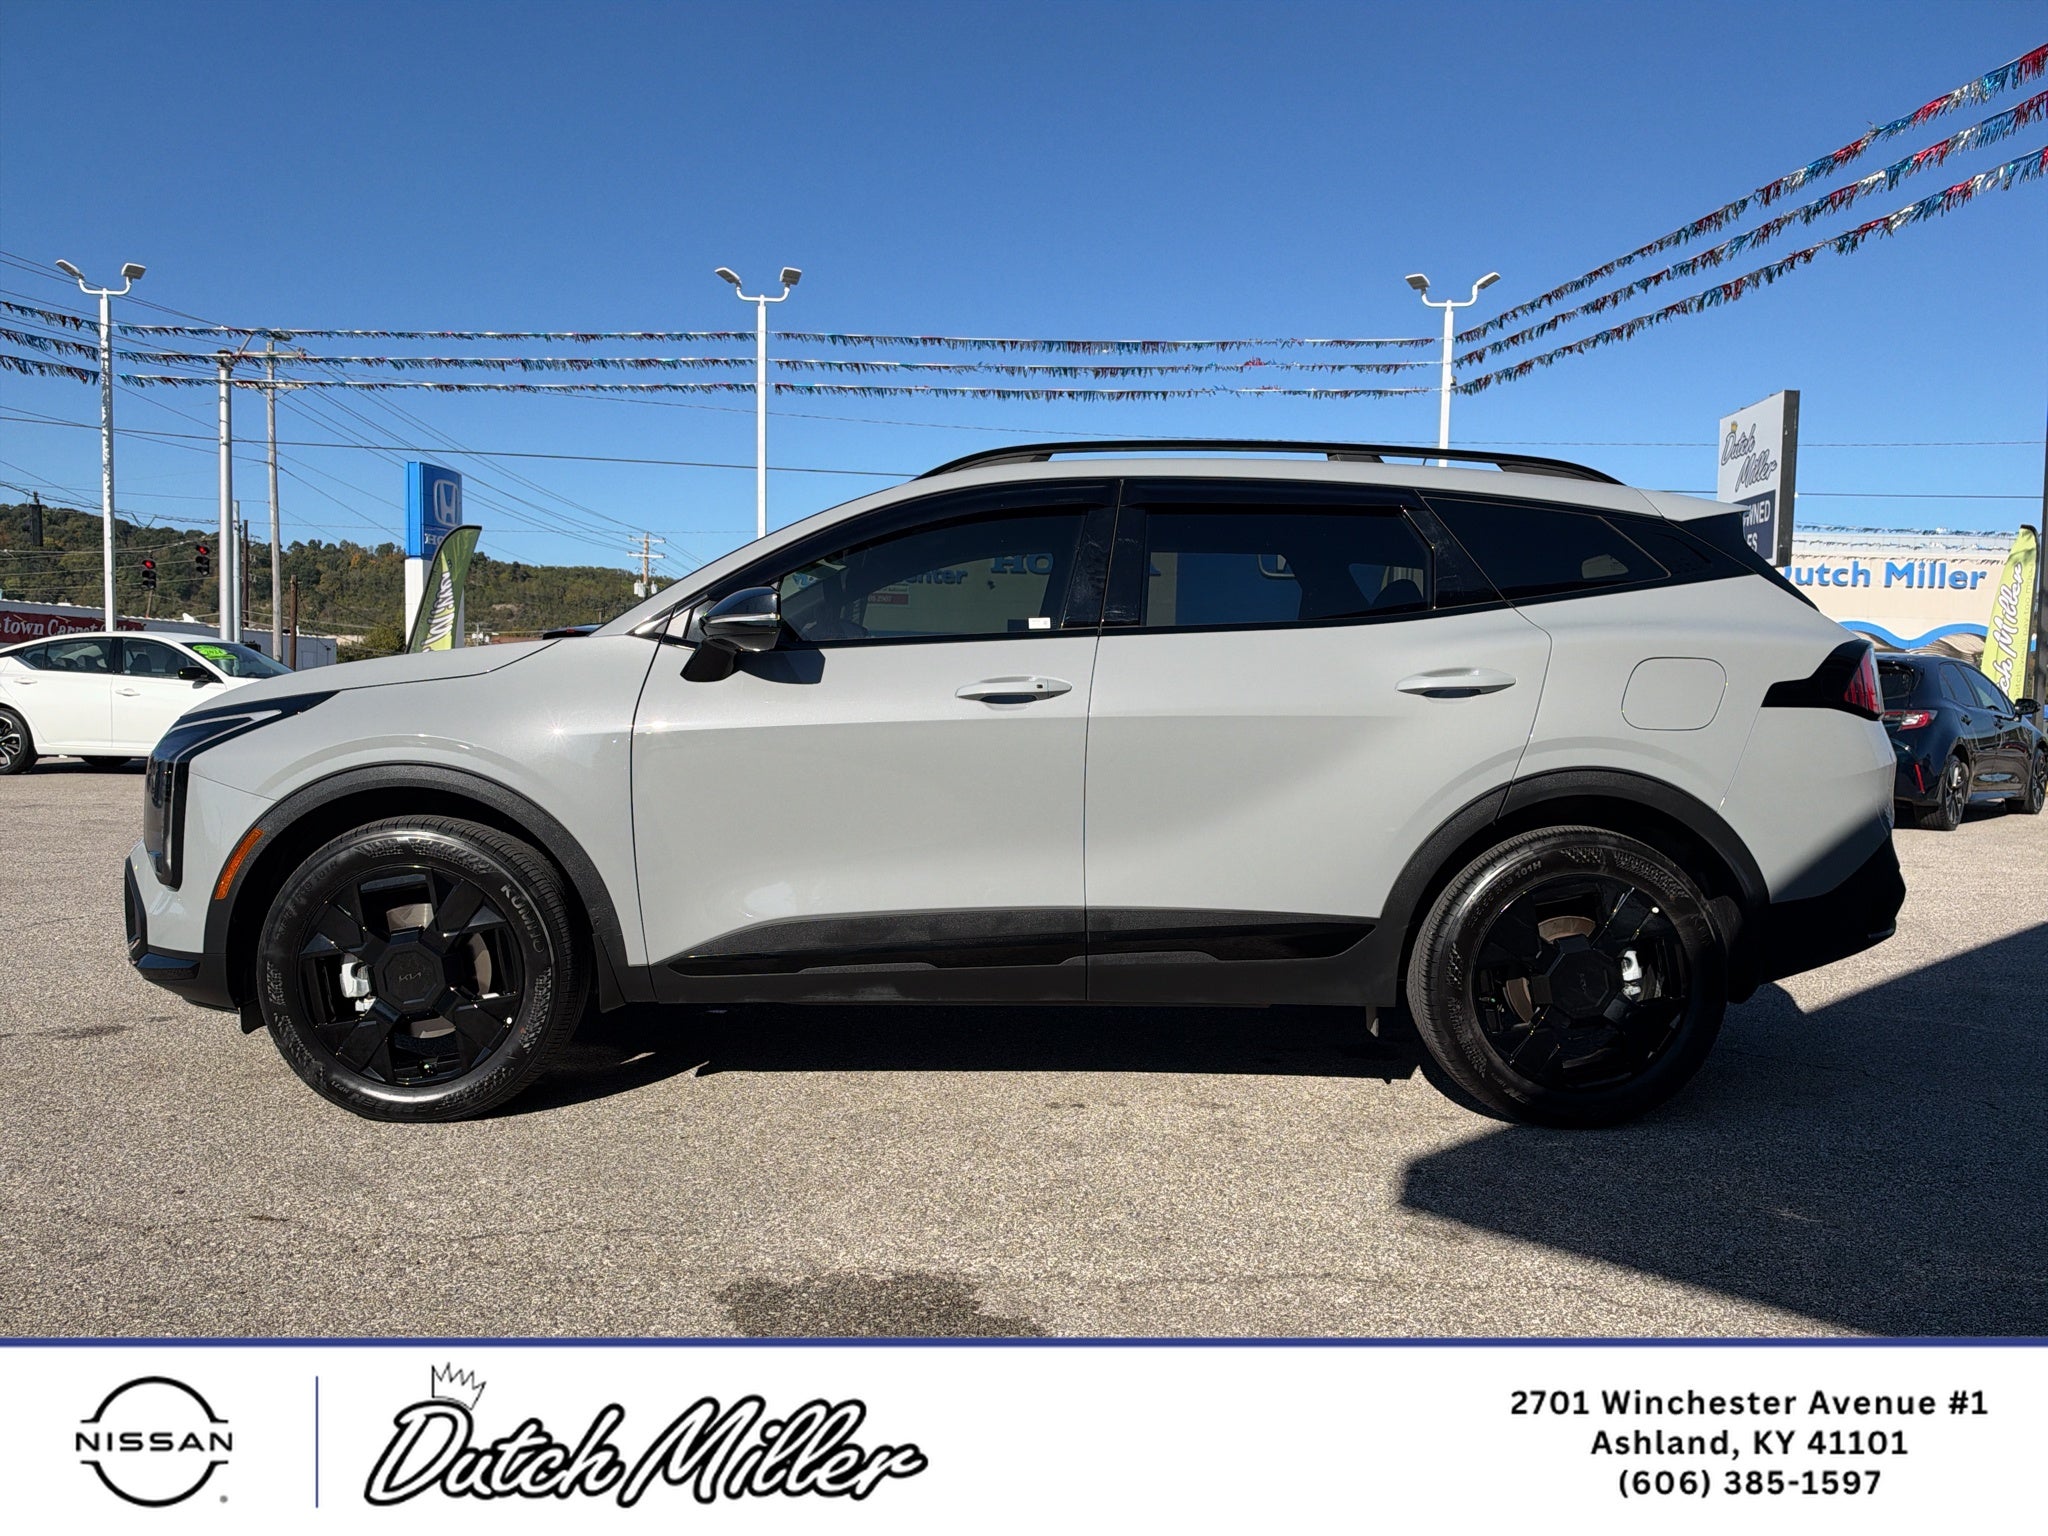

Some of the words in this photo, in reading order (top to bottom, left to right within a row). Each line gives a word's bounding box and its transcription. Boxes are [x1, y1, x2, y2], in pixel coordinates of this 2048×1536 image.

[1720, 423, 1756, 466] Dutch
[1735, 448, 1777, 493] Miller
[1884, 562, 1988, 590] Miller
[0, 616, 44, 636] town
[1993, 562, 2023, 659] Miller
[500, 883, 545, 953] KUMHO
